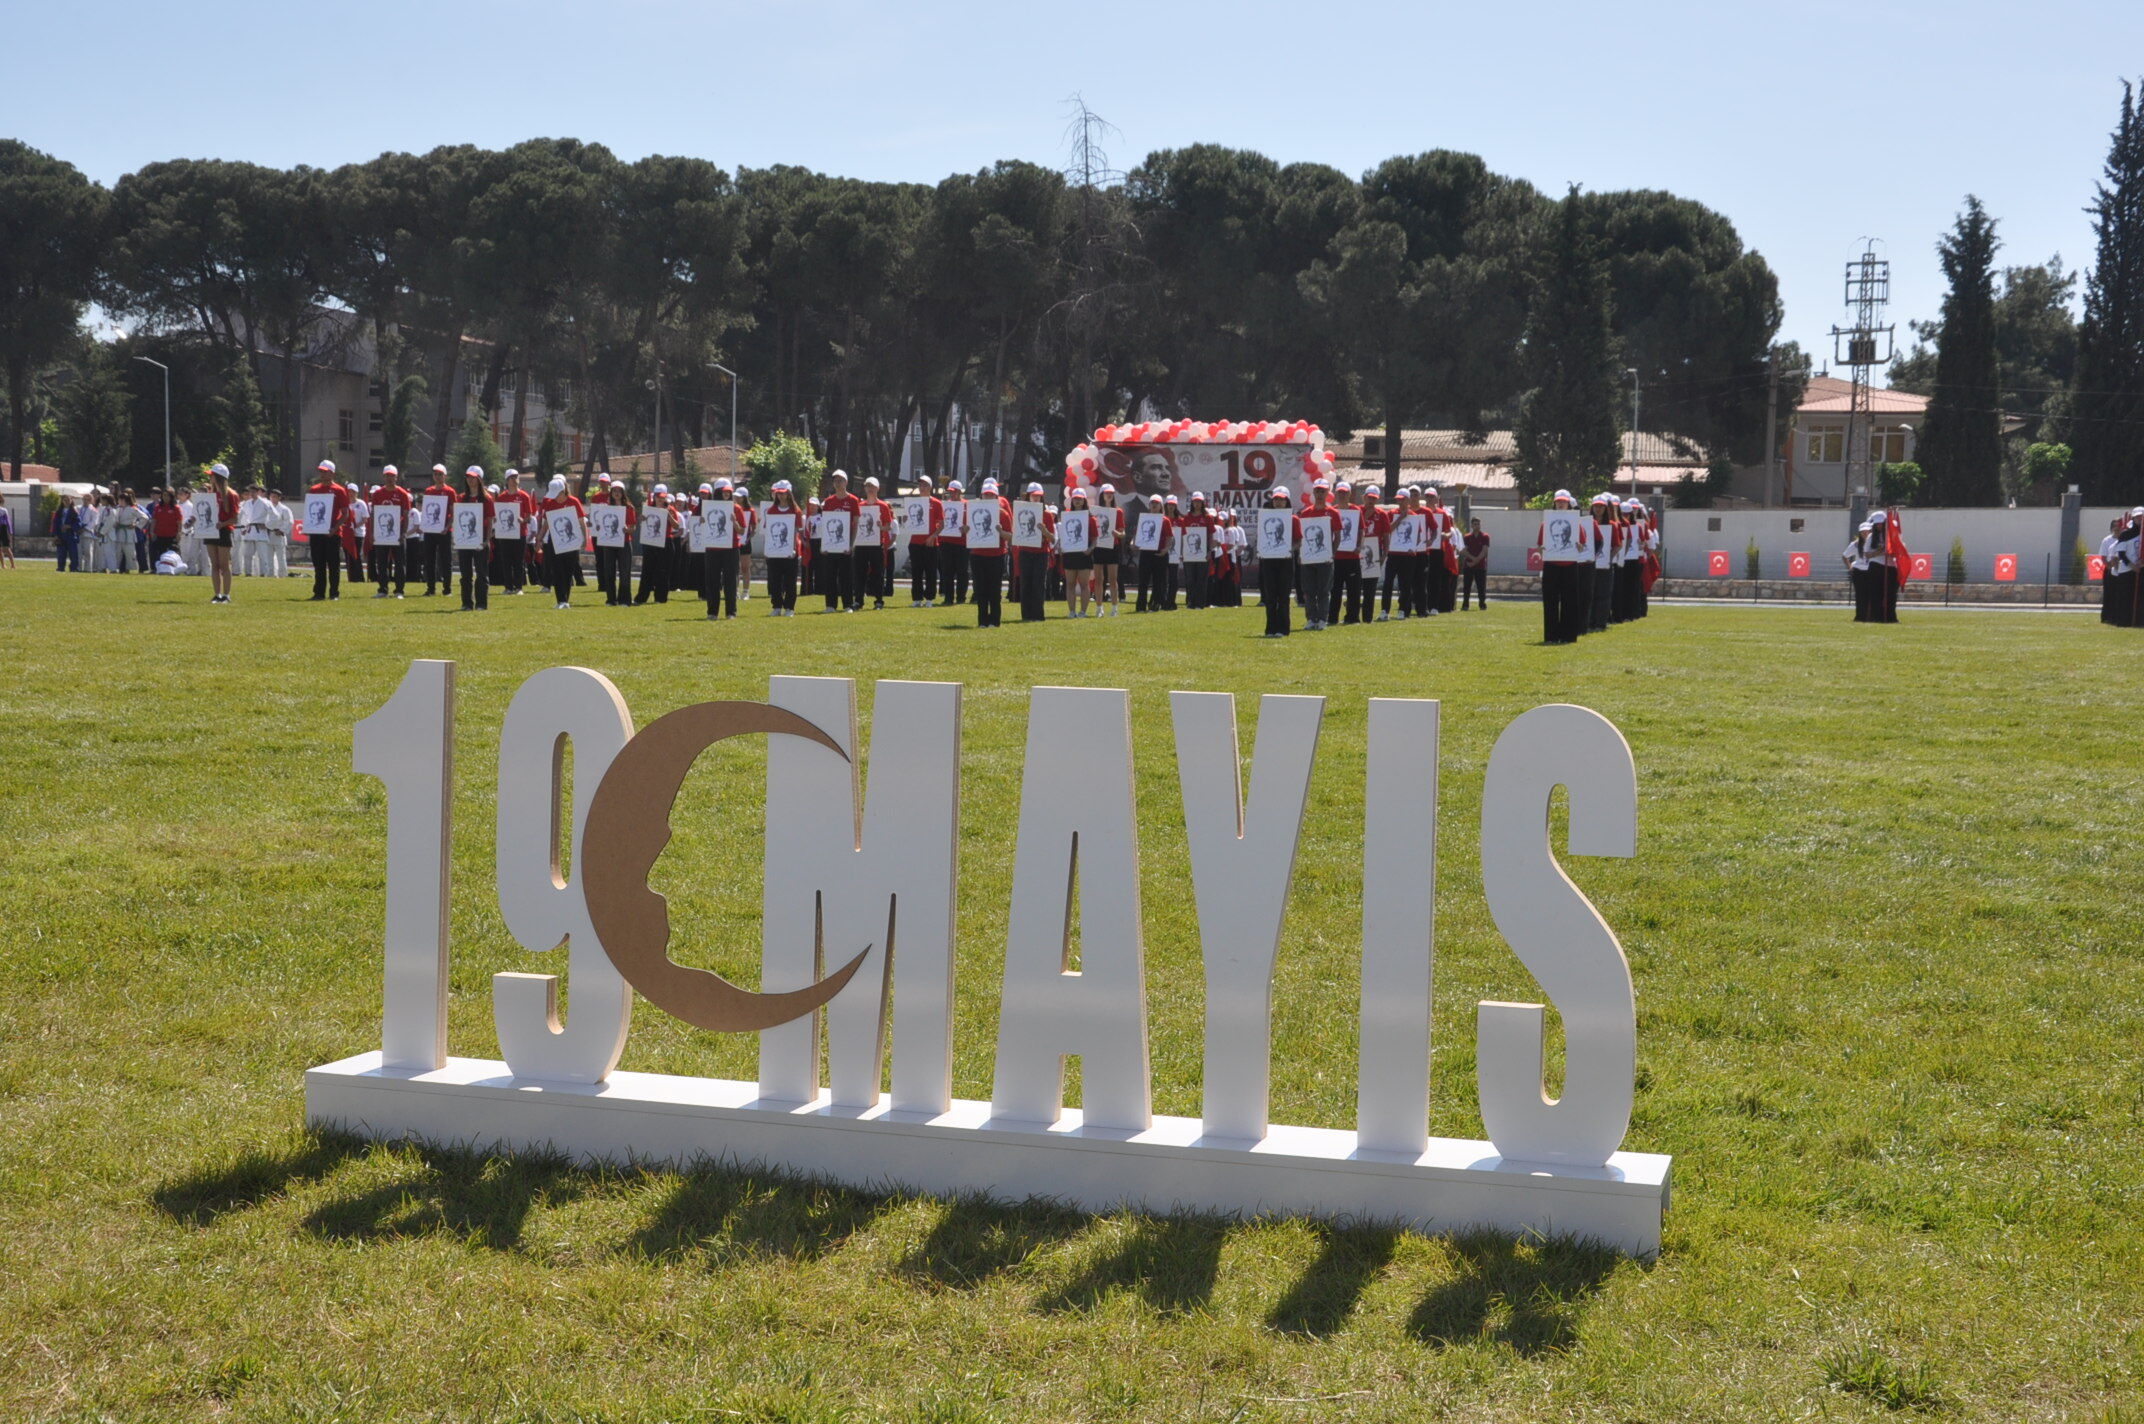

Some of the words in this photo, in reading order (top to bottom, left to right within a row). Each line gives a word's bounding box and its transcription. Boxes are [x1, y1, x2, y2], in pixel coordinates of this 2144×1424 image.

[1220, 450, 1276, 490] 19
[353, 659, 634, 1084] 19
[758, 675, 1638, 1166] MAYIS
